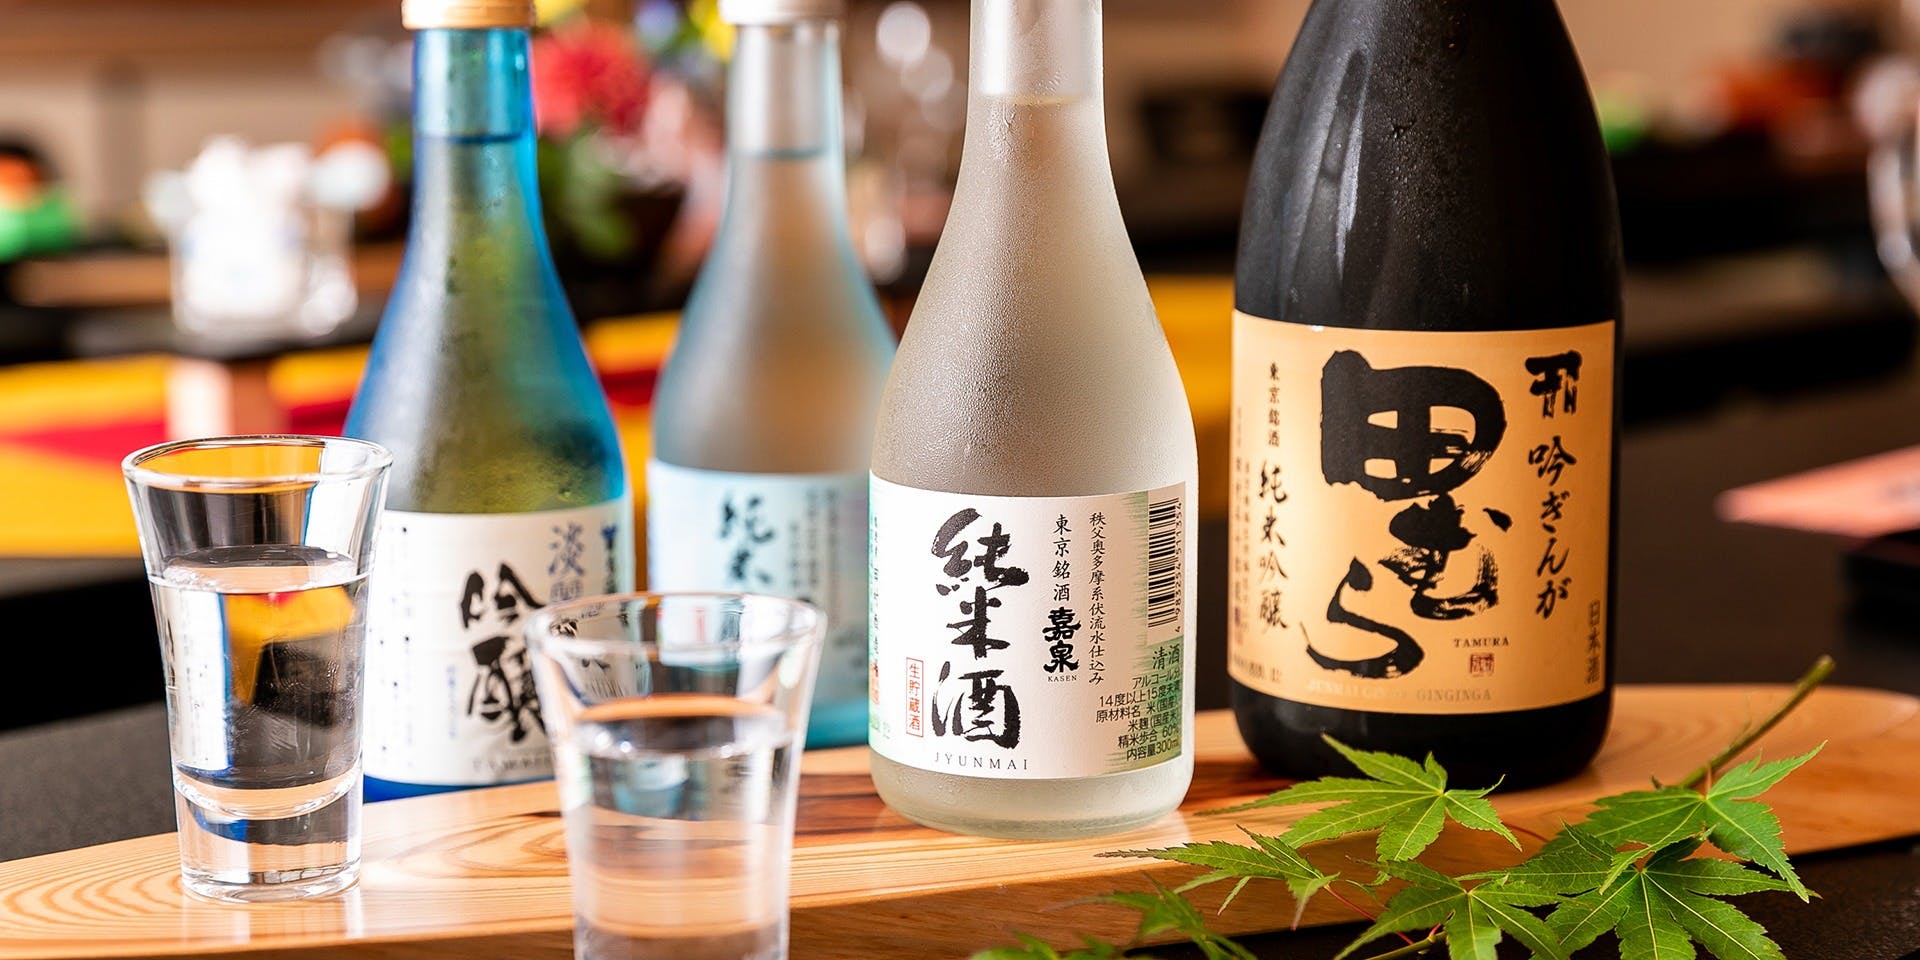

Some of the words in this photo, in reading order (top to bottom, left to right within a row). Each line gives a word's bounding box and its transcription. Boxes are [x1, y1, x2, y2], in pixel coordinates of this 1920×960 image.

[1266, 362, 1281, 447] 東京銘酒
[1258, 457, 1290, 633] 純米吟醸
[1300, 349, 1513, 679] 田むら
[1528, 435, 1577, 619] 吟ぎんが
[1051, 513, 1073, 602] 東京銘酒
[1088, 511, 1107, 686] 秩父奥多摩系伏流水仕込み
[931, 508, 1030, 750] 純米酒
[1042, 606, 1082, 673] 嘉泉
[1152, 643, 1180, 670] 清酒
[1453, 636, 1510, 648] TAMURA
[1586, 600, 1602, 684] 日本酒
[1047, 674, 1078, 682] KASEN
[1096, 705, 1141, 724] 原材料名
[933, 751, 1030, 771] JYUNMAI
[1117, 728, 1158, 749] 精米歩合
